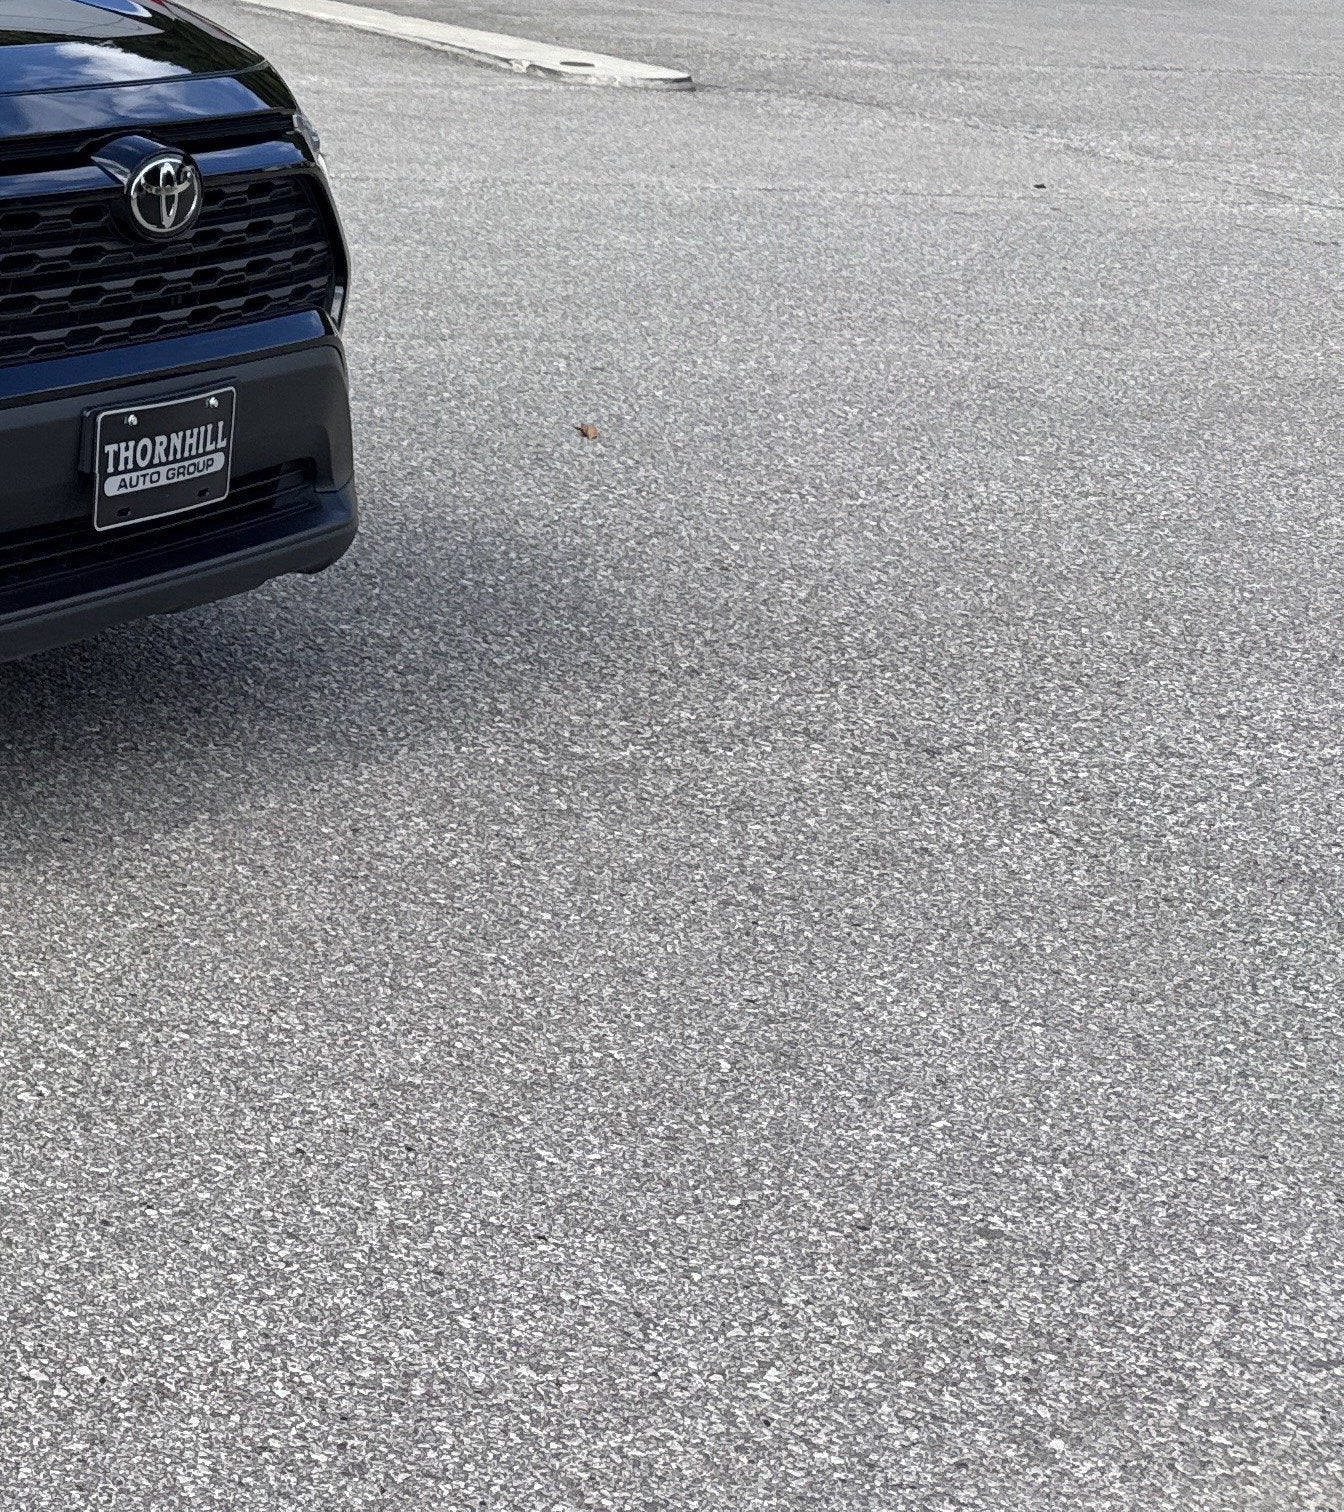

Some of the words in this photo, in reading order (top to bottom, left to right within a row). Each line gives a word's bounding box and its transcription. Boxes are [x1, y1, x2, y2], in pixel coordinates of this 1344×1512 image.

[104, 420, 227, 474] THORNHILL
[117, 471, 161, 491] AUTO
[166, 458, 215, 480] GROUP
